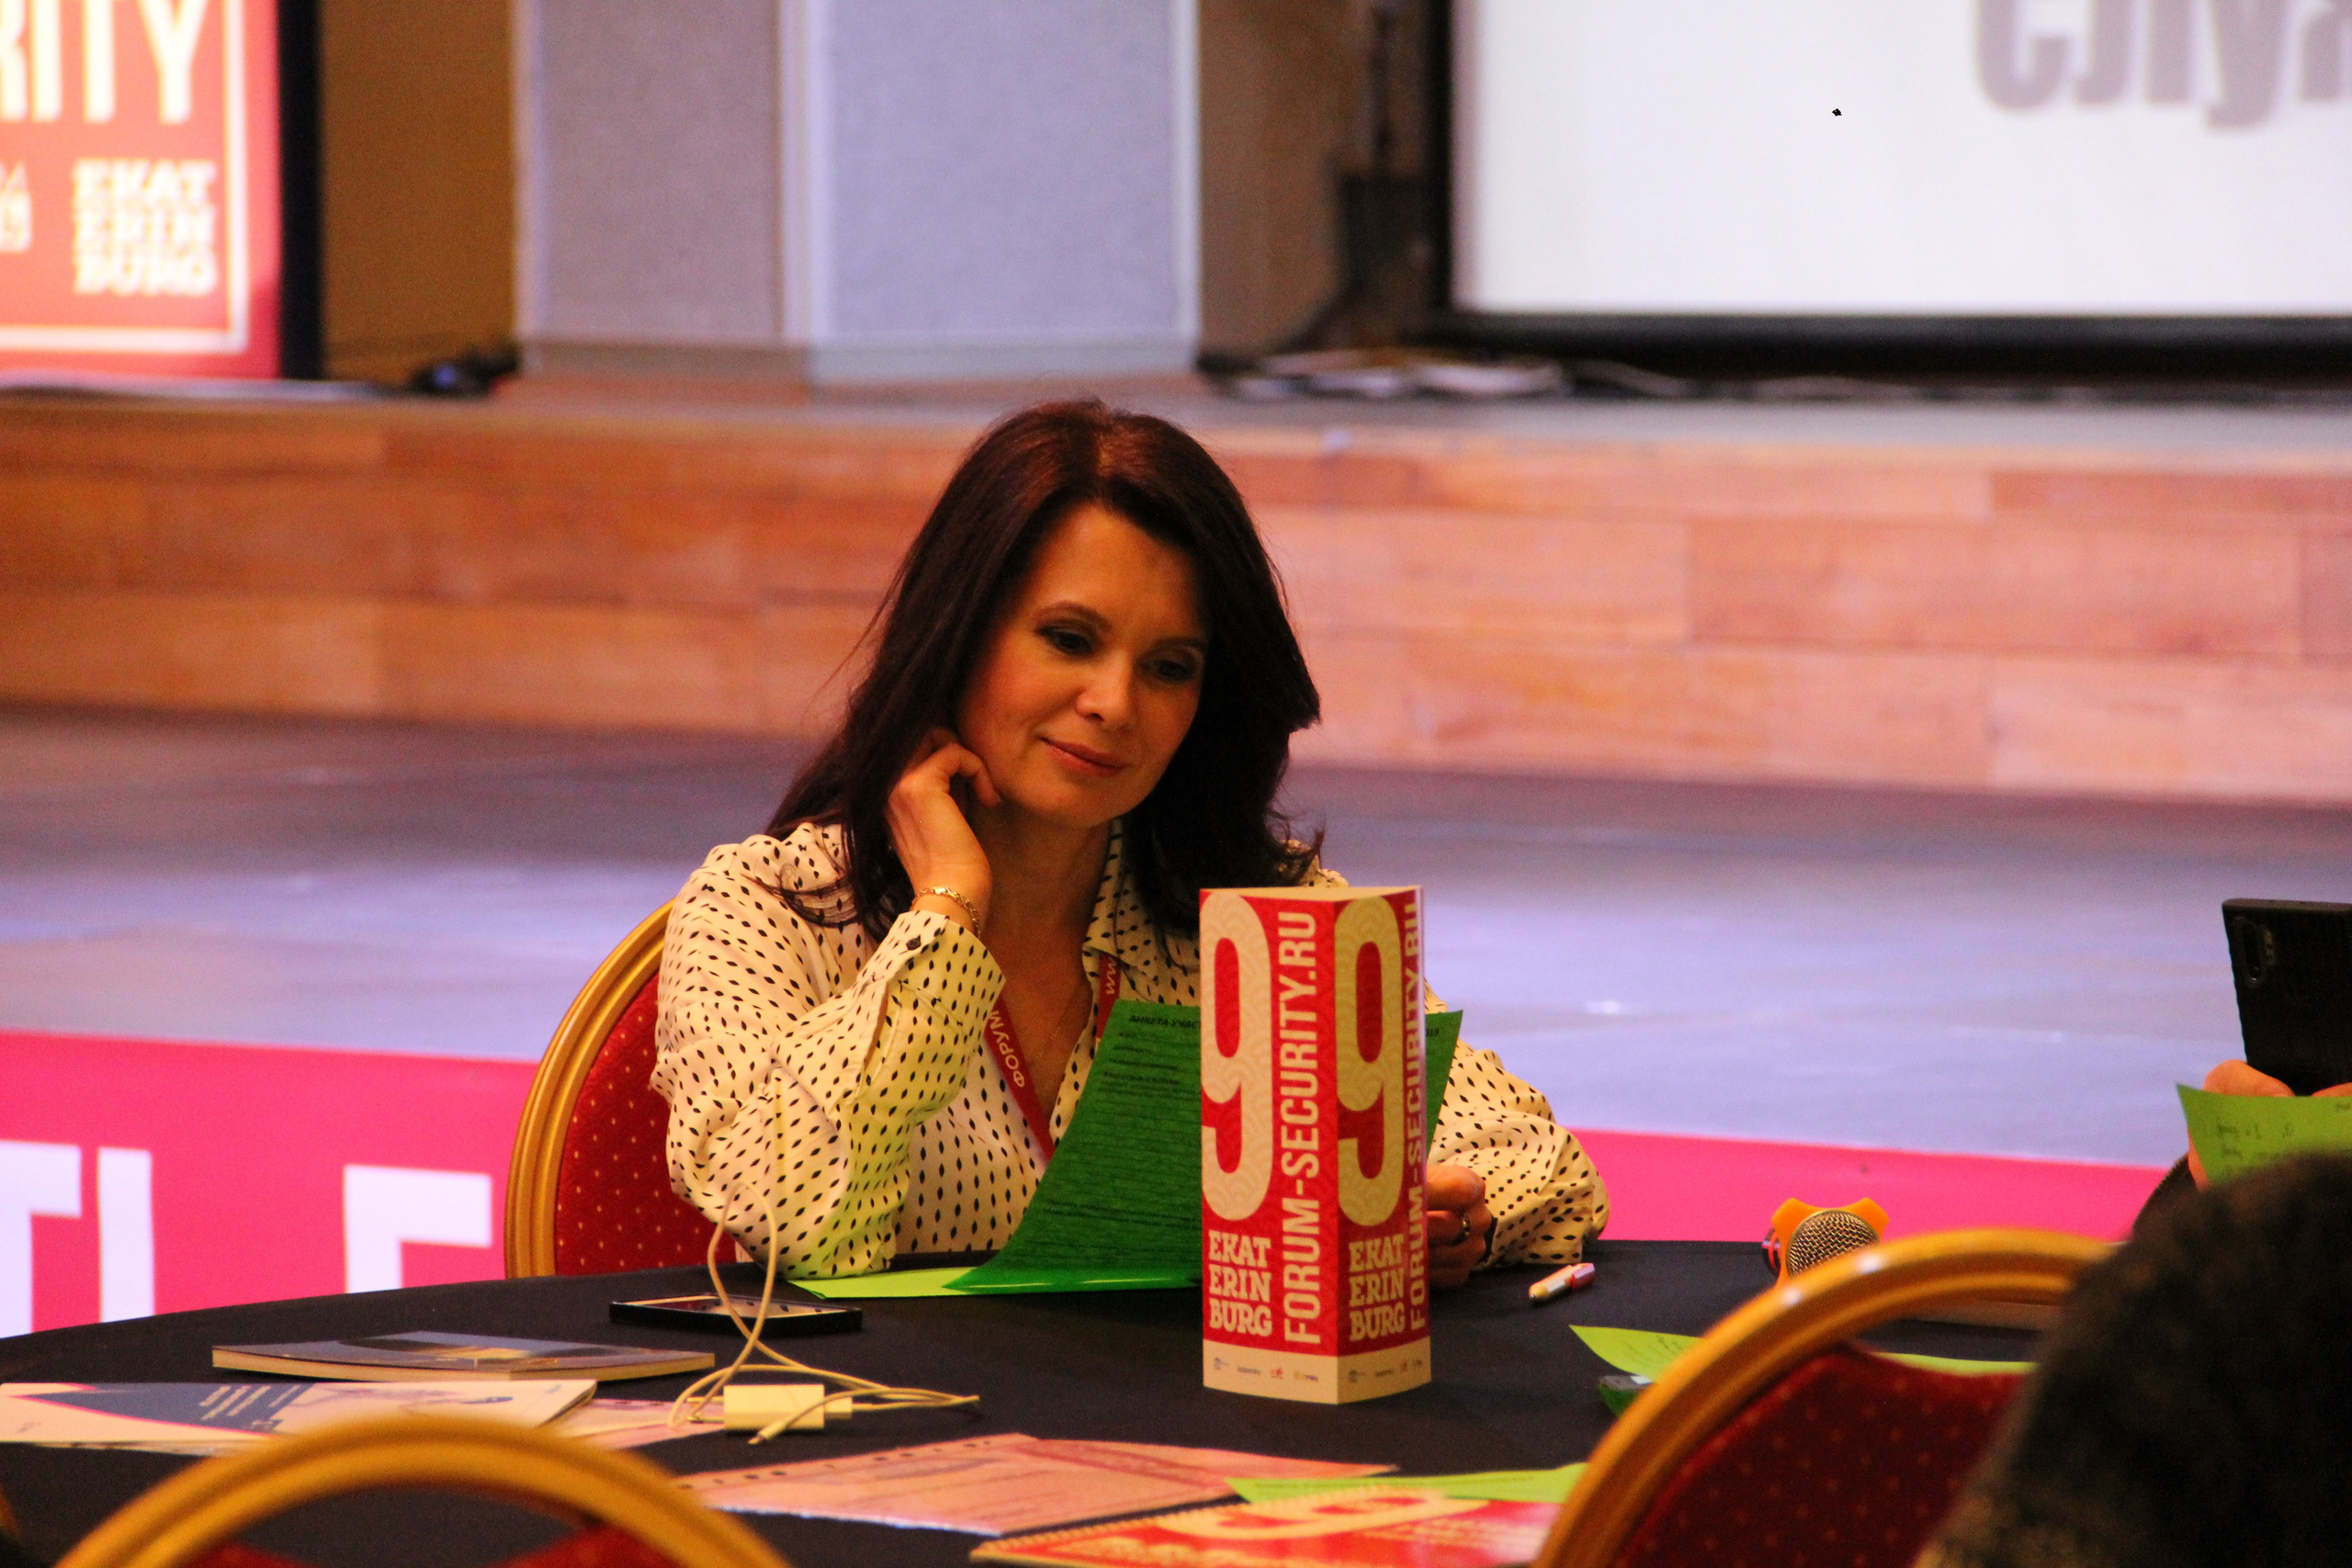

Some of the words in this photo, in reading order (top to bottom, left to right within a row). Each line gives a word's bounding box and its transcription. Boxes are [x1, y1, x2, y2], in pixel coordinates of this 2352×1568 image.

[1128, 1014, 1170, 1027] АНКЕТА
[1170, 1017, 1201, 1031] УЧАС
[989, 1010, 1026, 1089] ФОРУМ
[1200, 890, 1274, 1221] 9
[1334, 895, 1405, 1226] 9
[1278, 911, 1321, 1345] FORUM-SECURITY.RU
[1404, 902, 1425, 1331] FORUM-SECURITYRU
[1208, 1229, 1272, 1269] EKAT
[1349, 1233, 1405, 1273] EKAT
[1208, 1262, 1272, 1303] ERIN
[1349, 1267, 1405, 1308] ERIN
[1209, 1297, 1273, 1337] BURG
[1349, 1301, 1406, 1342] BURG
